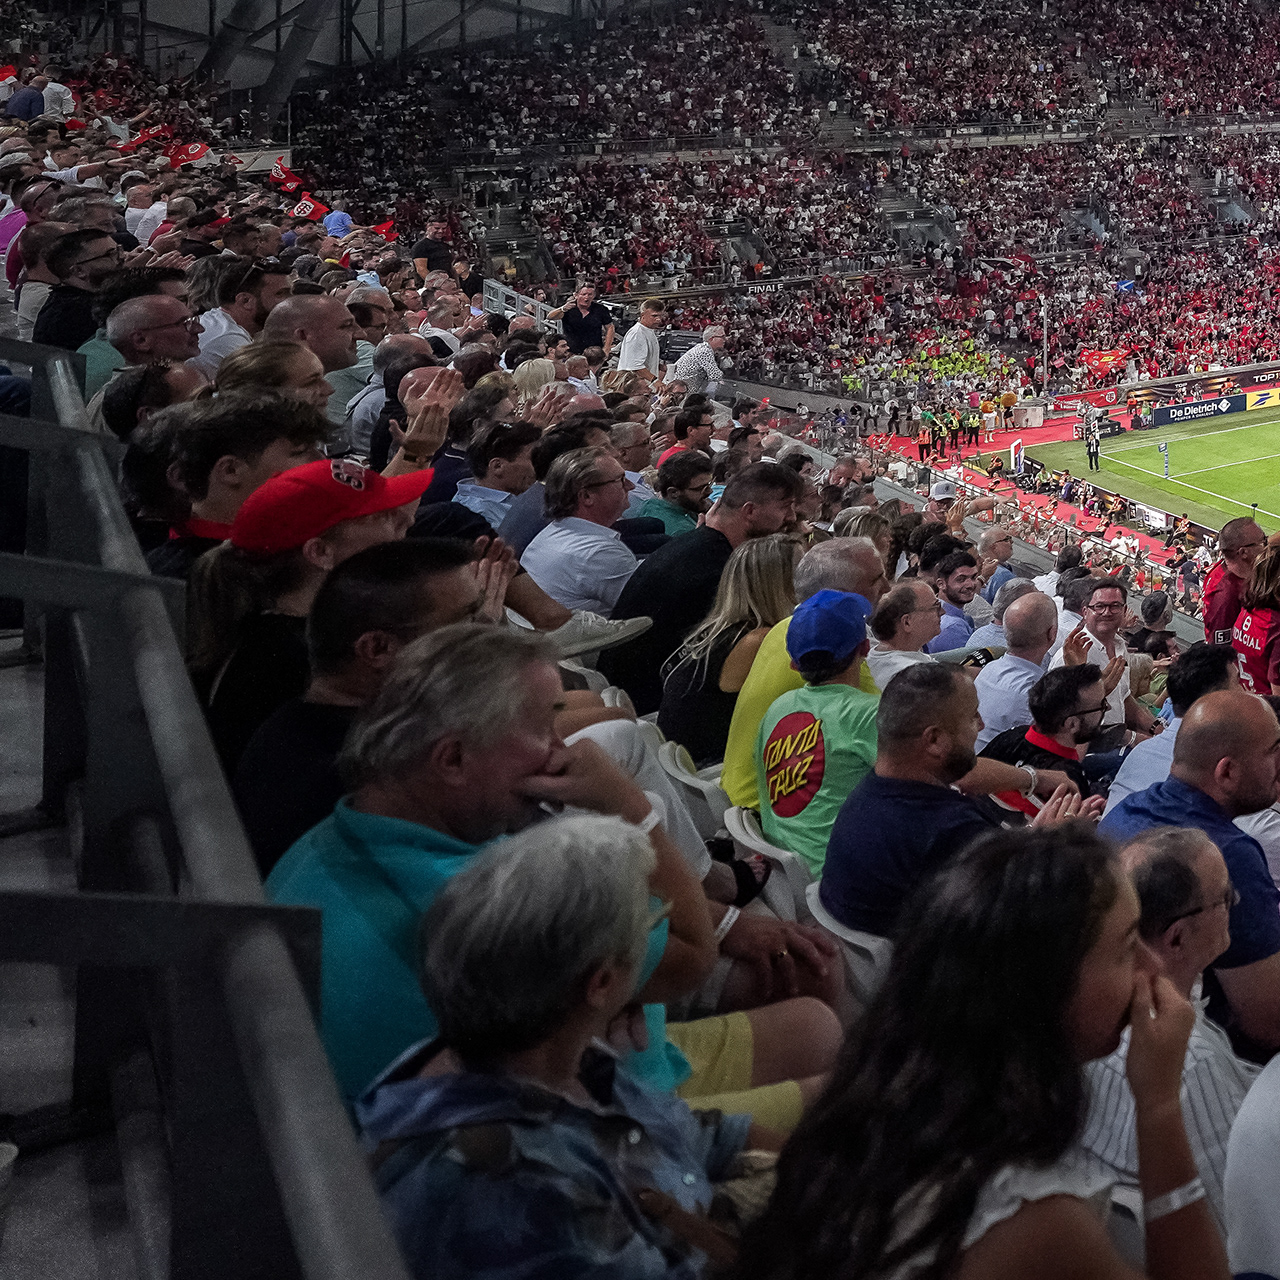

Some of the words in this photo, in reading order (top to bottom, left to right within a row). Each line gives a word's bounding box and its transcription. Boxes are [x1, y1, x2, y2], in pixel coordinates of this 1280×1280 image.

[749, 283, 784, 294] FINALE
[1170, 409, 1183, 419] De
[1185, 401, 1218, 415] Dietrich
[766, 719, 821, 771] SANTA
[768, 752, 815, 805] CRUZ
